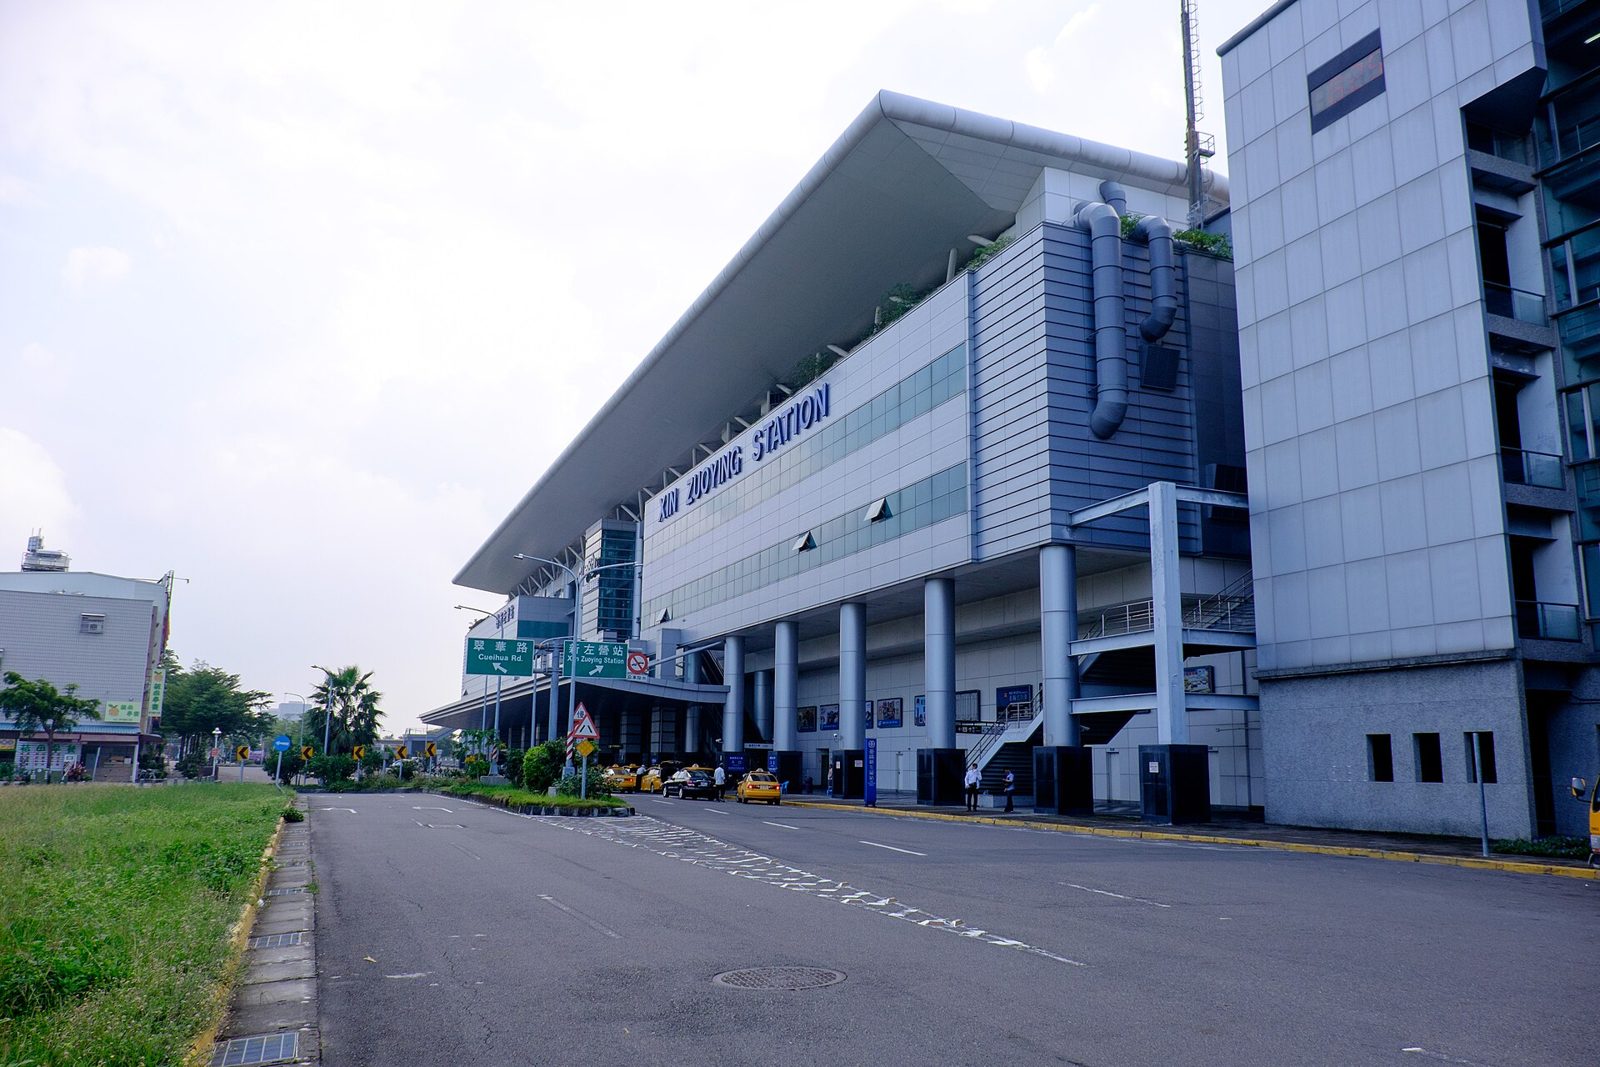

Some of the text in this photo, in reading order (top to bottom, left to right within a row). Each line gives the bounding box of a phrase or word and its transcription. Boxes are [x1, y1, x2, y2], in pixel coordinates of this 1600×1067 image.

[658, 382, 831, 523] XIN ZUOYING STATION
[473, 640, 528, 653] 翠華路
[478, 653, 524, 662] Cueihua Rd.
[580, 655, 603, 664] Zuoying
[603, 656, 625, 664] Station
